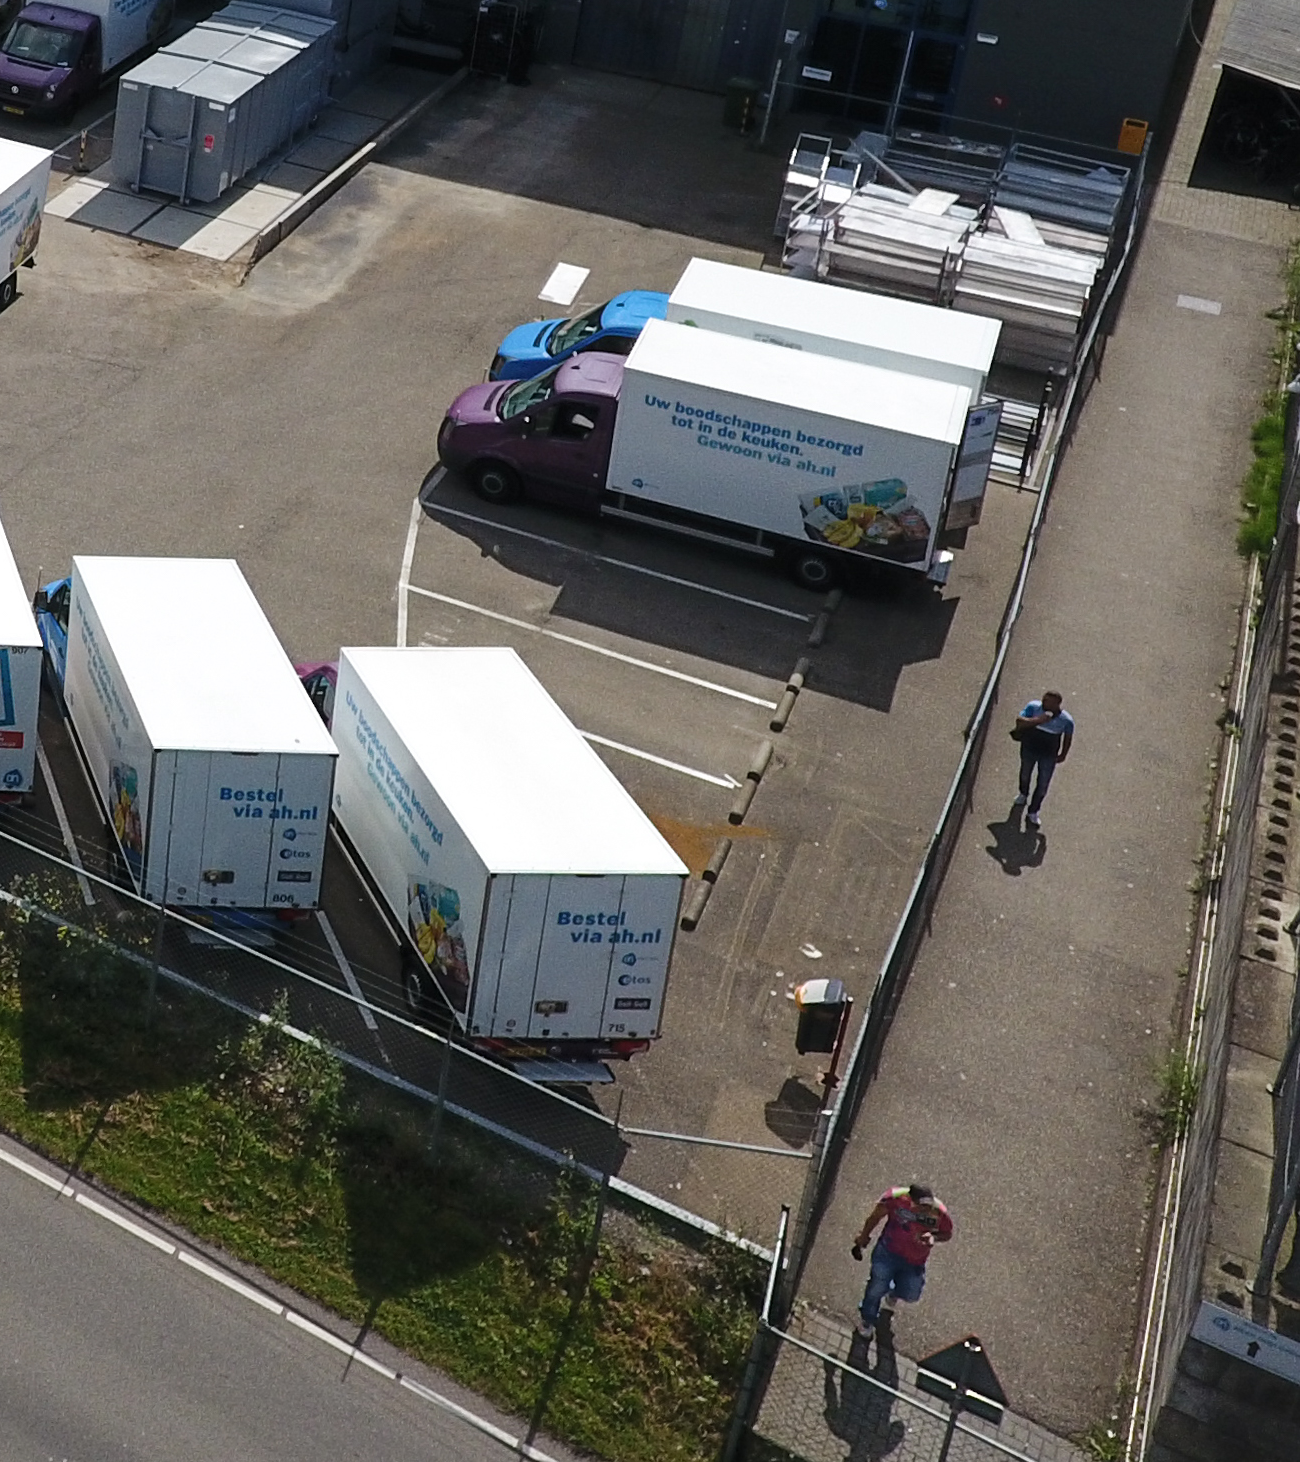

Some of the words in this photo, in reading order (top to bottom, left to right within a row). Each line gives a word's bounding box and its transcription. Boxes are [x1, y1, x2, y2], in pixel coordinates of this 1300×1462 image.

[644, 394, 671, 410] Uw
[675, 401, 792, 440] boodschappen
[796, 429, 864, 457] bezorgd
[671, 414, 694, 431] tot
[698, 420, 714, 434] in
[717, 425, 737, 442] de
[740, 431, 804, 457] keuken.
[697, 435, 763, 461] Gewoon
[767, 451, 792, 467] via
[795, 458, 838, 479] ah.nl
[12, 647, 29, 655] 907
[220, 787, 284, 802] Bestel
[233, 804, 263, 818] via
[268, 805, 318, 820] ah.nl
[272, 894, 295, 903] 806
[557, 911, 626, 926] Bestel
[570, 929, 602, 943] via
[608, 929, 661, 944] ah.nl
[609, 1023, 625, 1032] 715
